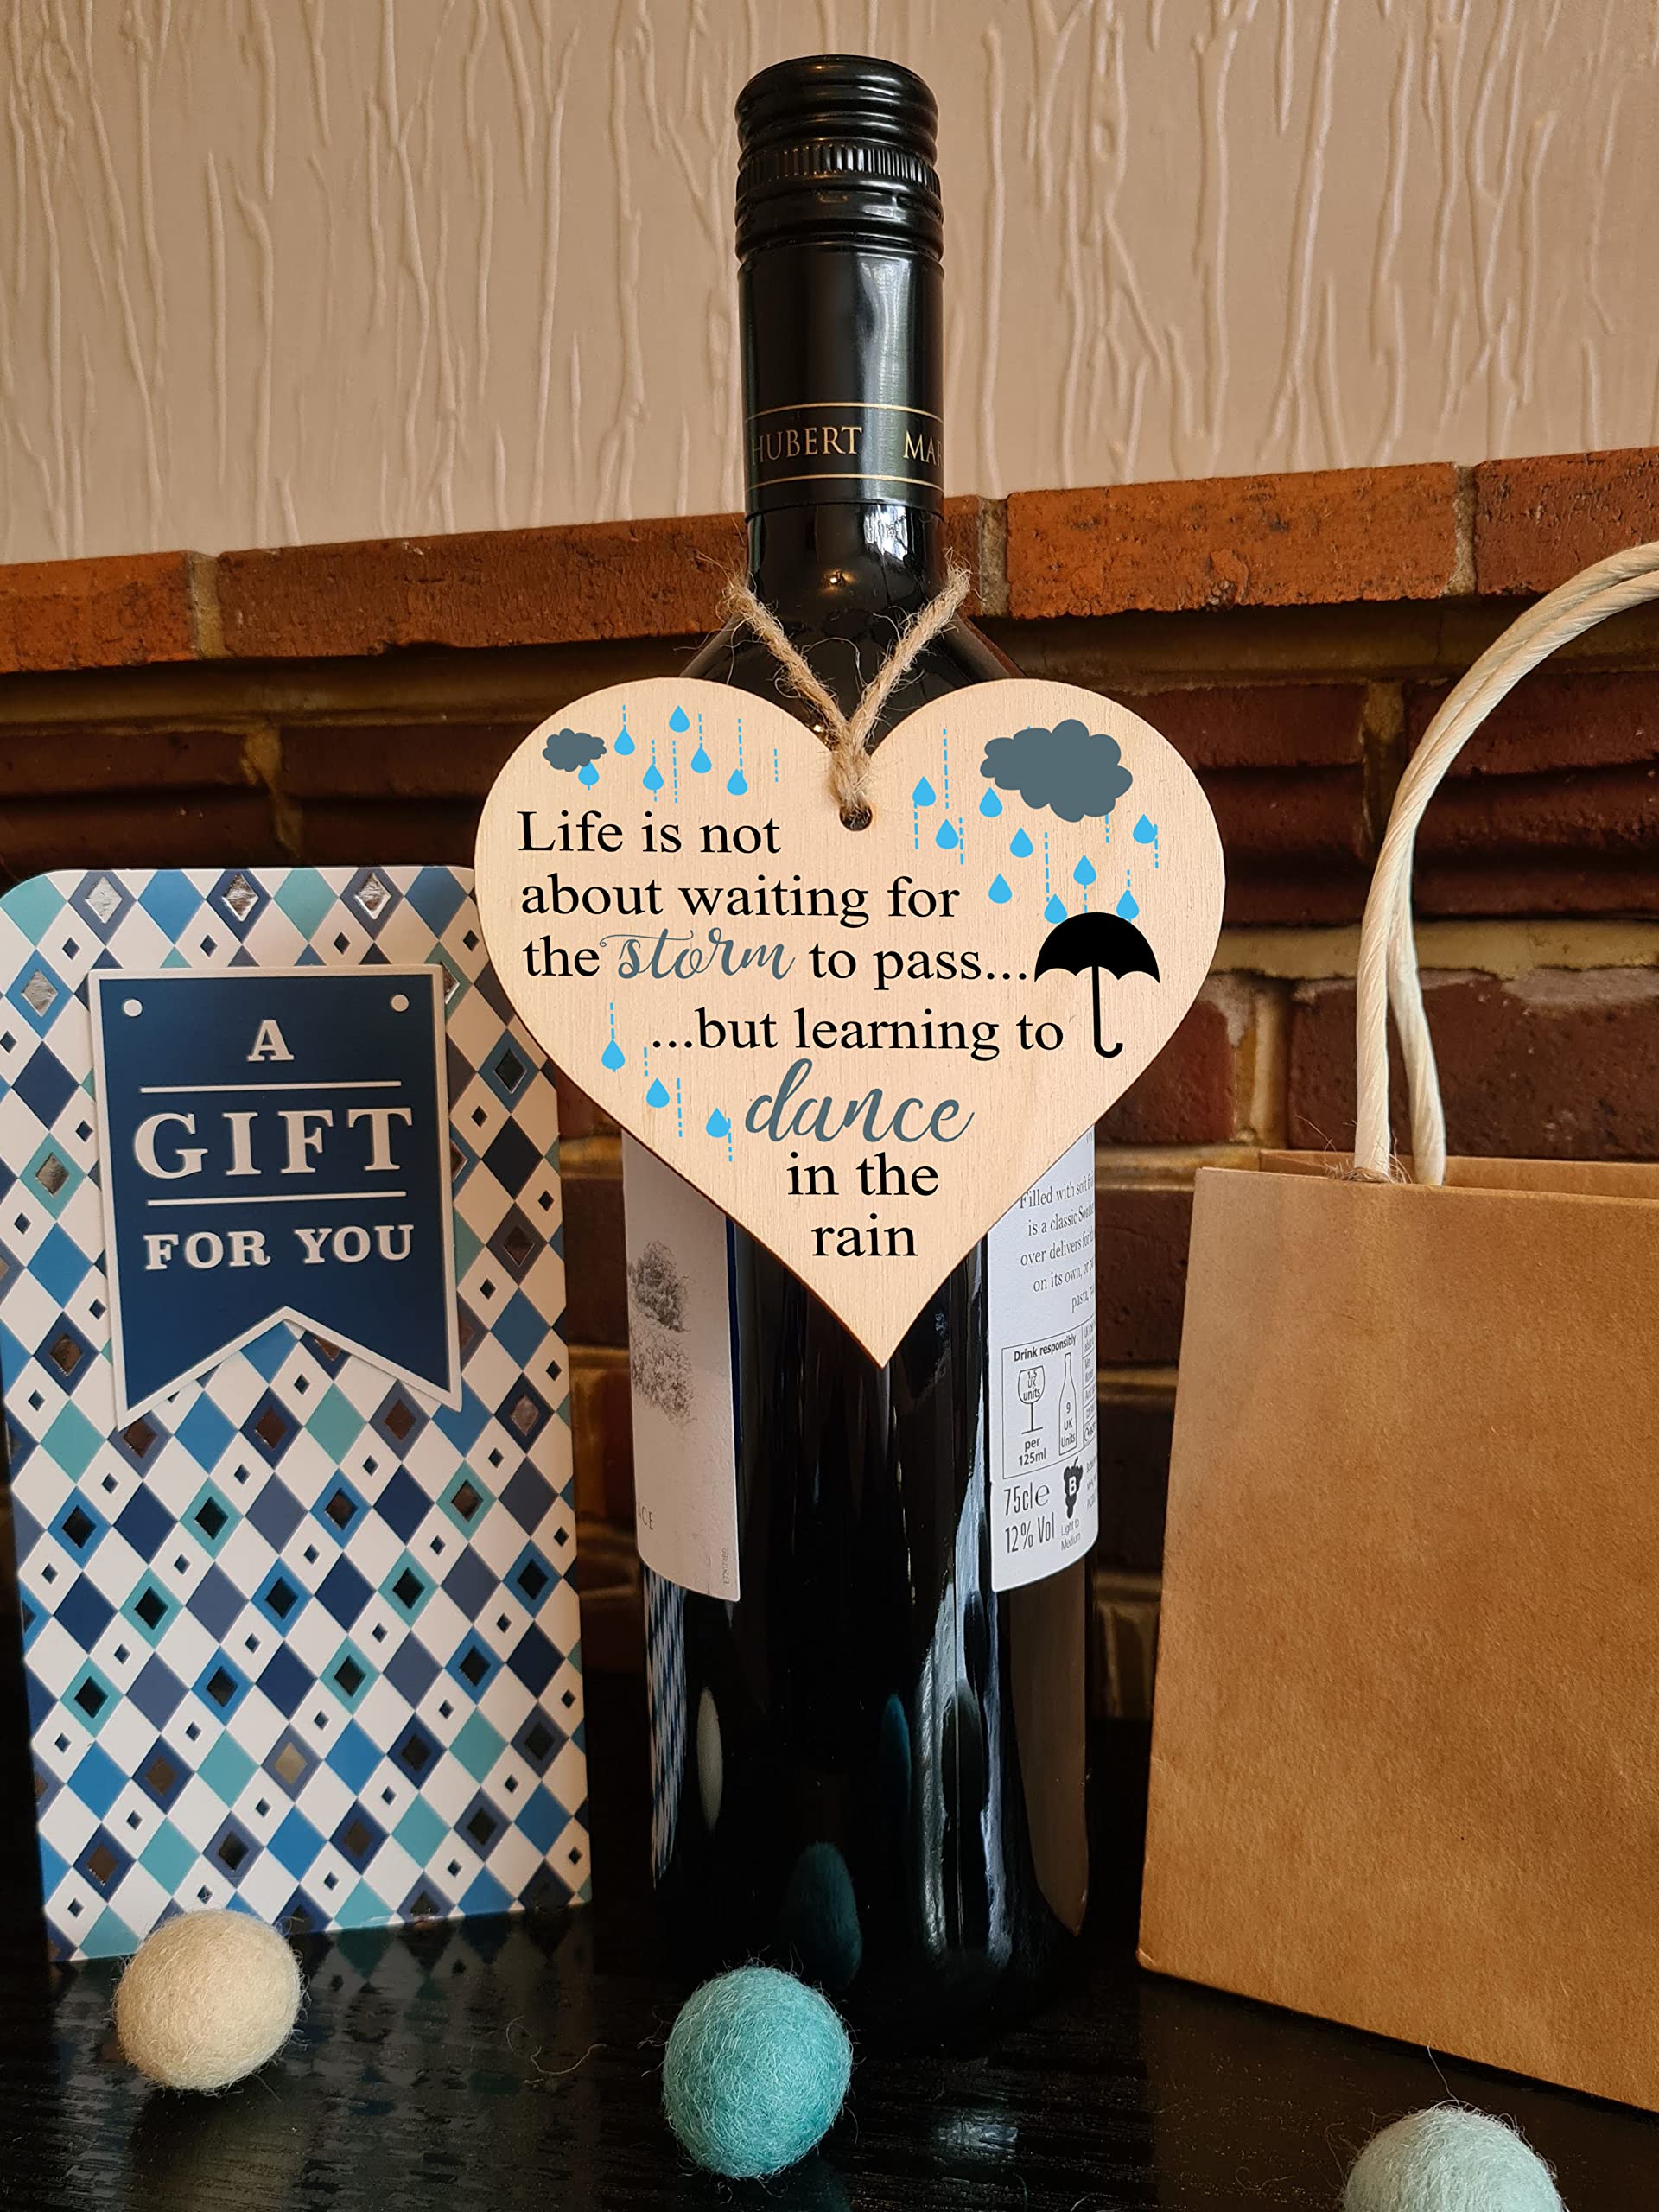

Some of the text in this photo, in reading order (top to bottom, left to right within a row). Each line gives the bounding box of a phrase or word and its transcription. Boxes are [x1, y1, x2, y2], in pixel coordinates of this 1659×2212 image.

[752, 426, 862, 466] HUBERT
[517, 810, 781, 854] Life is not
[521, 873, 960, 928] about waiting for
[522, 927, 1027, 991] the storm to pass...
[247, 1020, 295, 1062] A
[652, 1007, 1064, 1061] ...but learning to
[745, 1058, 975, 1143] dance
[133, 1108, 413, 1179] GIFT
[786, 1151, 938, 1197] in the
[1020, 1188, 1052, 1209] Filled
[1055, 1183, 1075, 1202] with
[811, 1212, 918, 1257] rain
[1027, 1219, 1038, 1236] is
[1041, 1222, 1047, 1234] a
[1050, 1209, 1077, 1231] classic
[143, 1224, 414, 1270] FOR YOU
[1020, 1251, 1046, 1267] over
[1049, 1238, 1082, 1260] delivers
[1033, 1277, 1047, 1292] on
[1051, 1271, 1063, 1287] its
[1065, 1267, 1082, 1284] own,
[1014, 1347, 1038, 1362] Drink
[1039, 1333, 1077, 1356] responsibly
[1023, 1388, 1040, 1401] units
[1027, 1379, 1036, 1389] UK
[1064, 1418, 1073, 1430] UK
[1065, 1402, 1071, 1414] 9
[1019, 1447, 1046, 1466] 125ml
[1025, 1437, 1040, 1452] per
[1061, 1433, 1076, 1448] Units
[1005, 1511, 1055, 1553] 12% Vol
